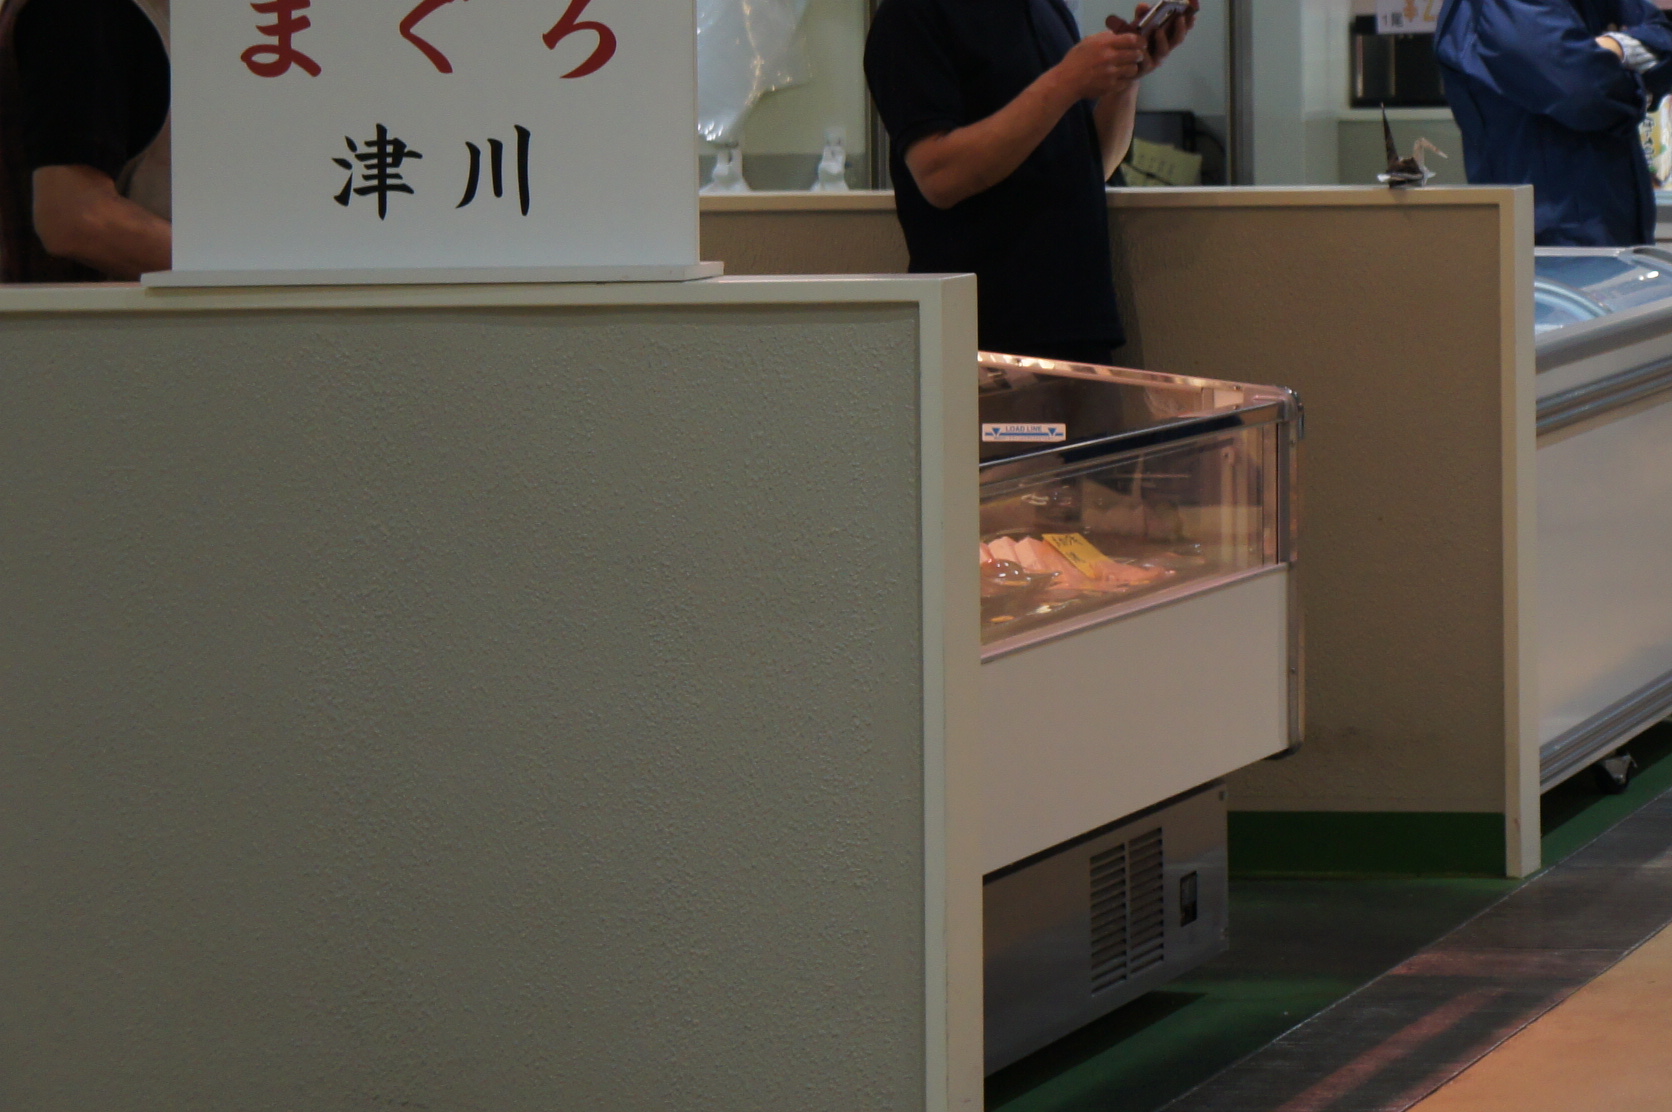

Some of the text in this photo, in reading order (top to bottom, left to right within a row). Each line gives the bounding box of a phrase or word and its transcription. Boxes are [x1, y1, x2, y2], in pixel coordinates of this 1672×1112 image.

[332, 122, 532, 221] 津川
[1005, 425, 1043, 433] LOAD LINE
